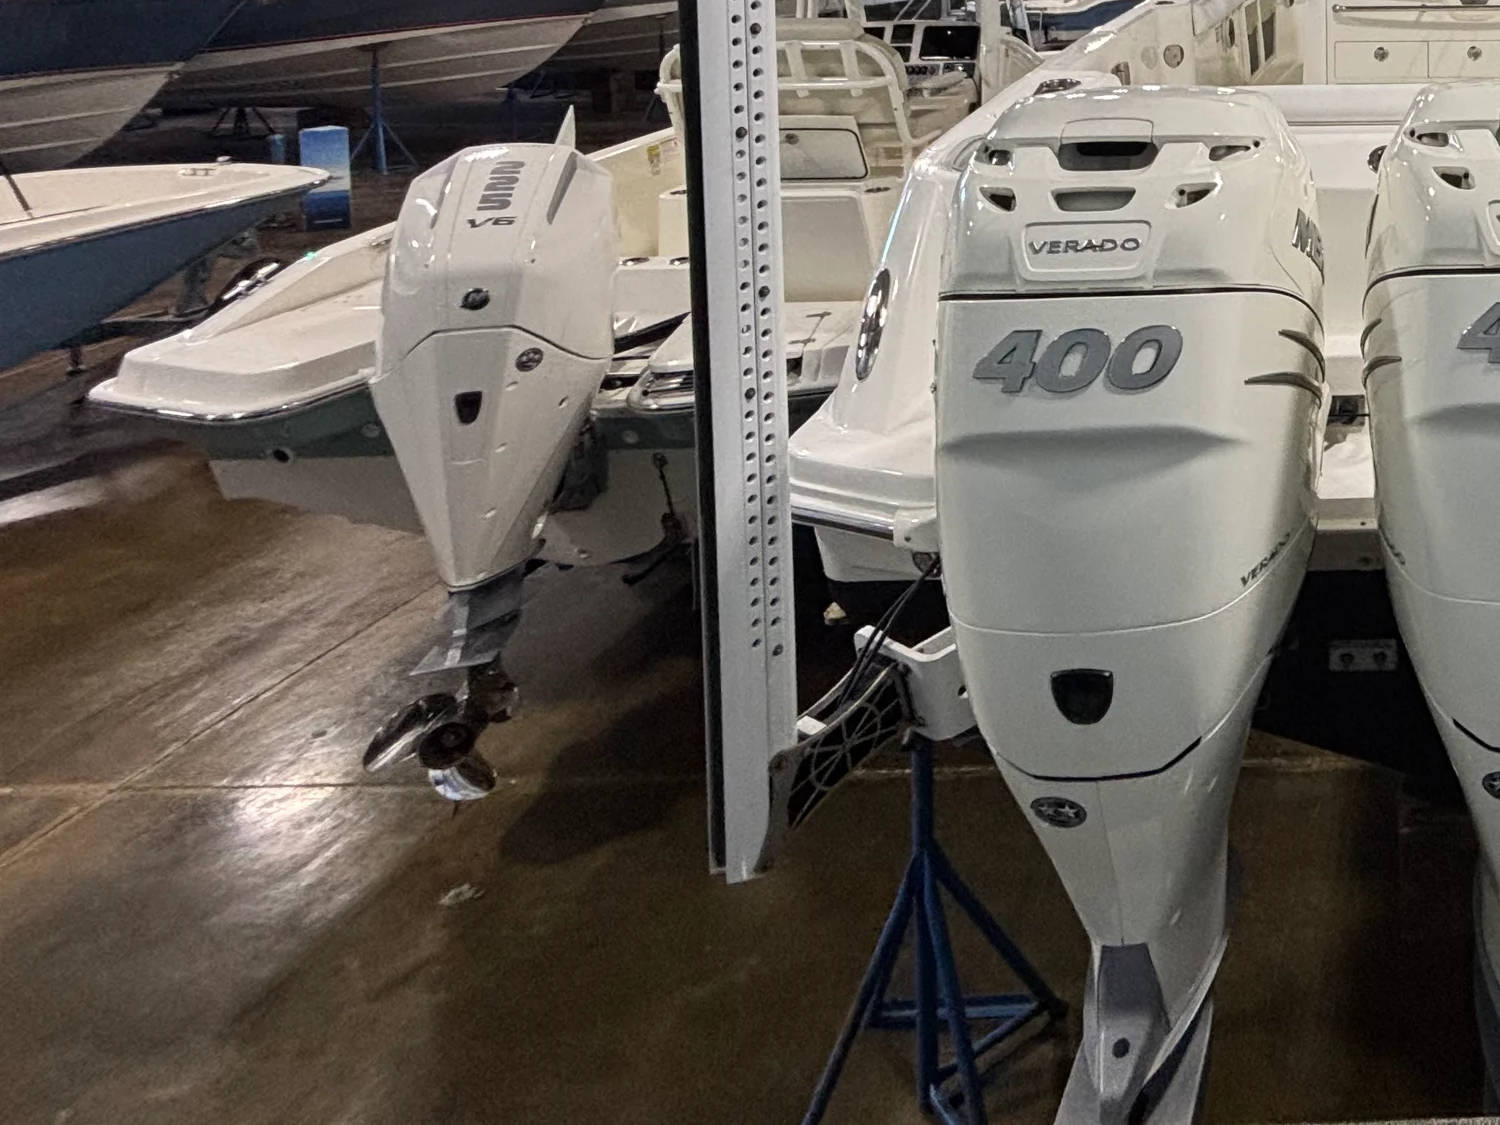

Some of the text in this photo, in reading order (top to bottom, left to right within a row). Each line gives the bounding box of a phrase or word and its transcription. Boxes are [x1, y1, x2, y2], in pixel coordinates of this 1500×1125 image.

[476, 160, 525, 212] 225
[466, 215, 518, 229] V6
[1028, 236, 1142, 256] VERADO
[972, 324, 1184, 395] 400
